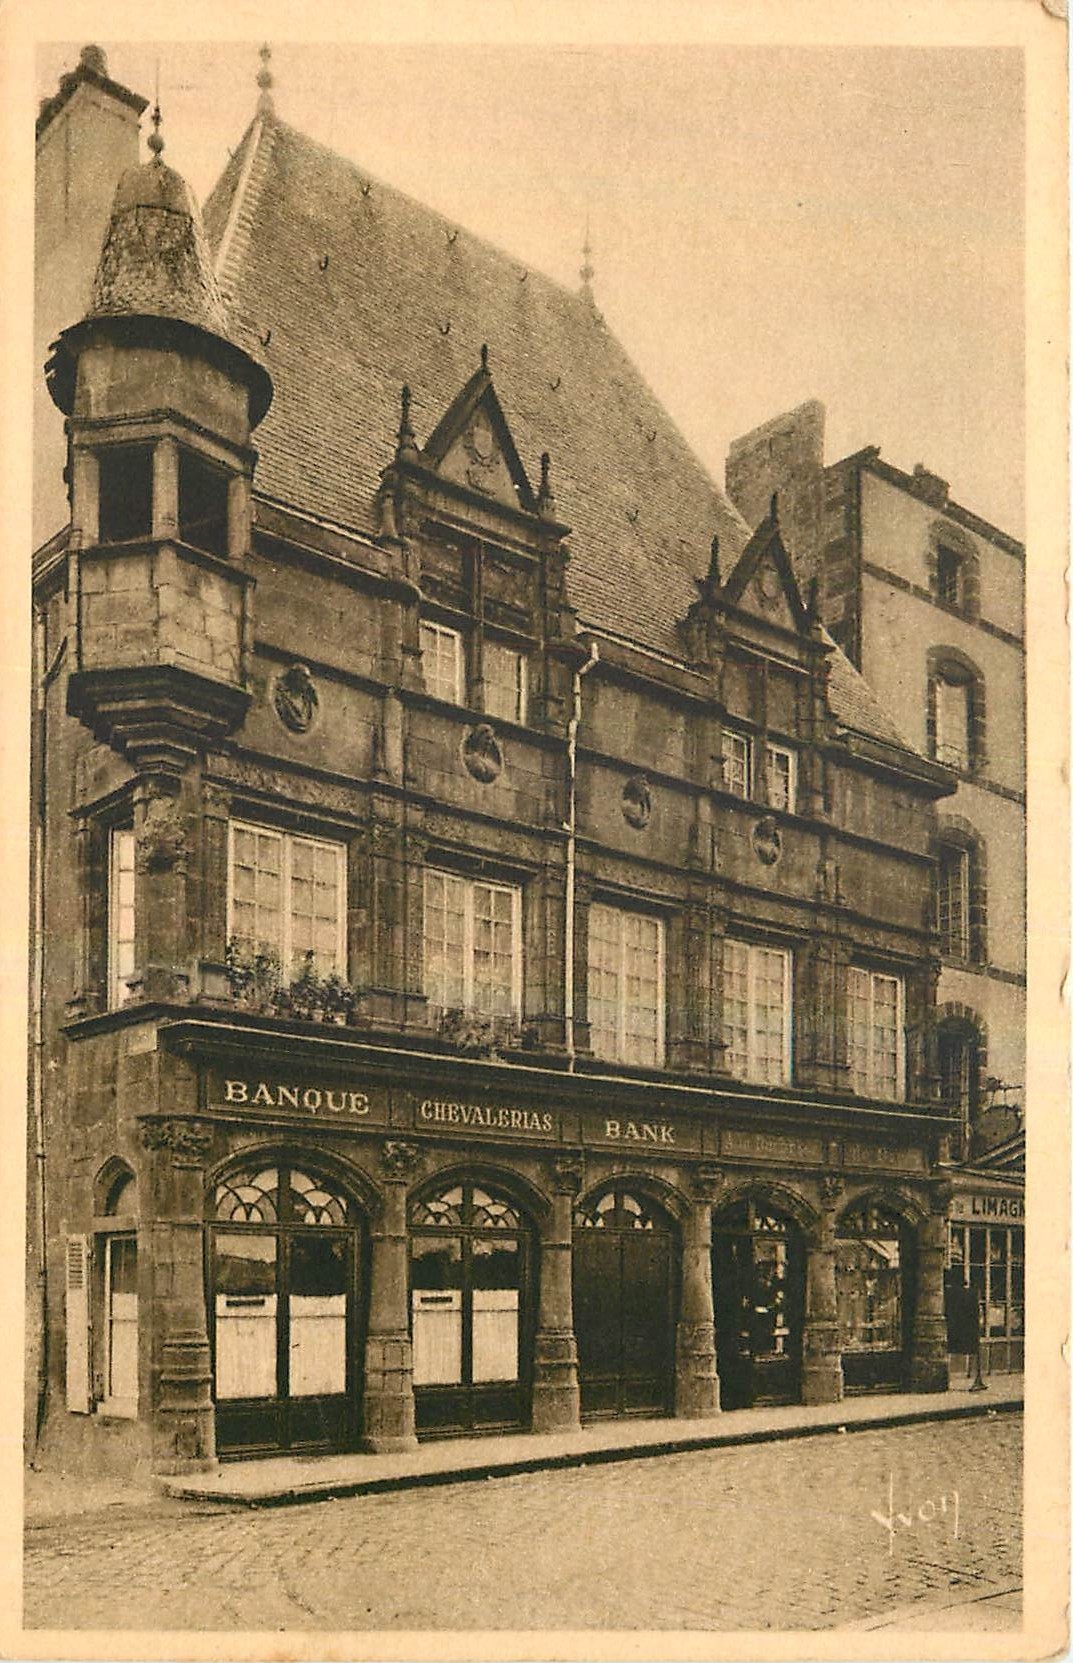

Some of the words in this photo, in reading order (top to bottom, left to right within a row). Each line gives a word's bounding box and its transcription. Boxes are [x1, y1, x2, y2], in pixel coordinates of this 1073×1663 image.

[224, 1080, 370, 1114] BANQUE
[420, 1100, 552, 1132] CHEVALERIAS
[605, 1120, 676, 1143] BANK
